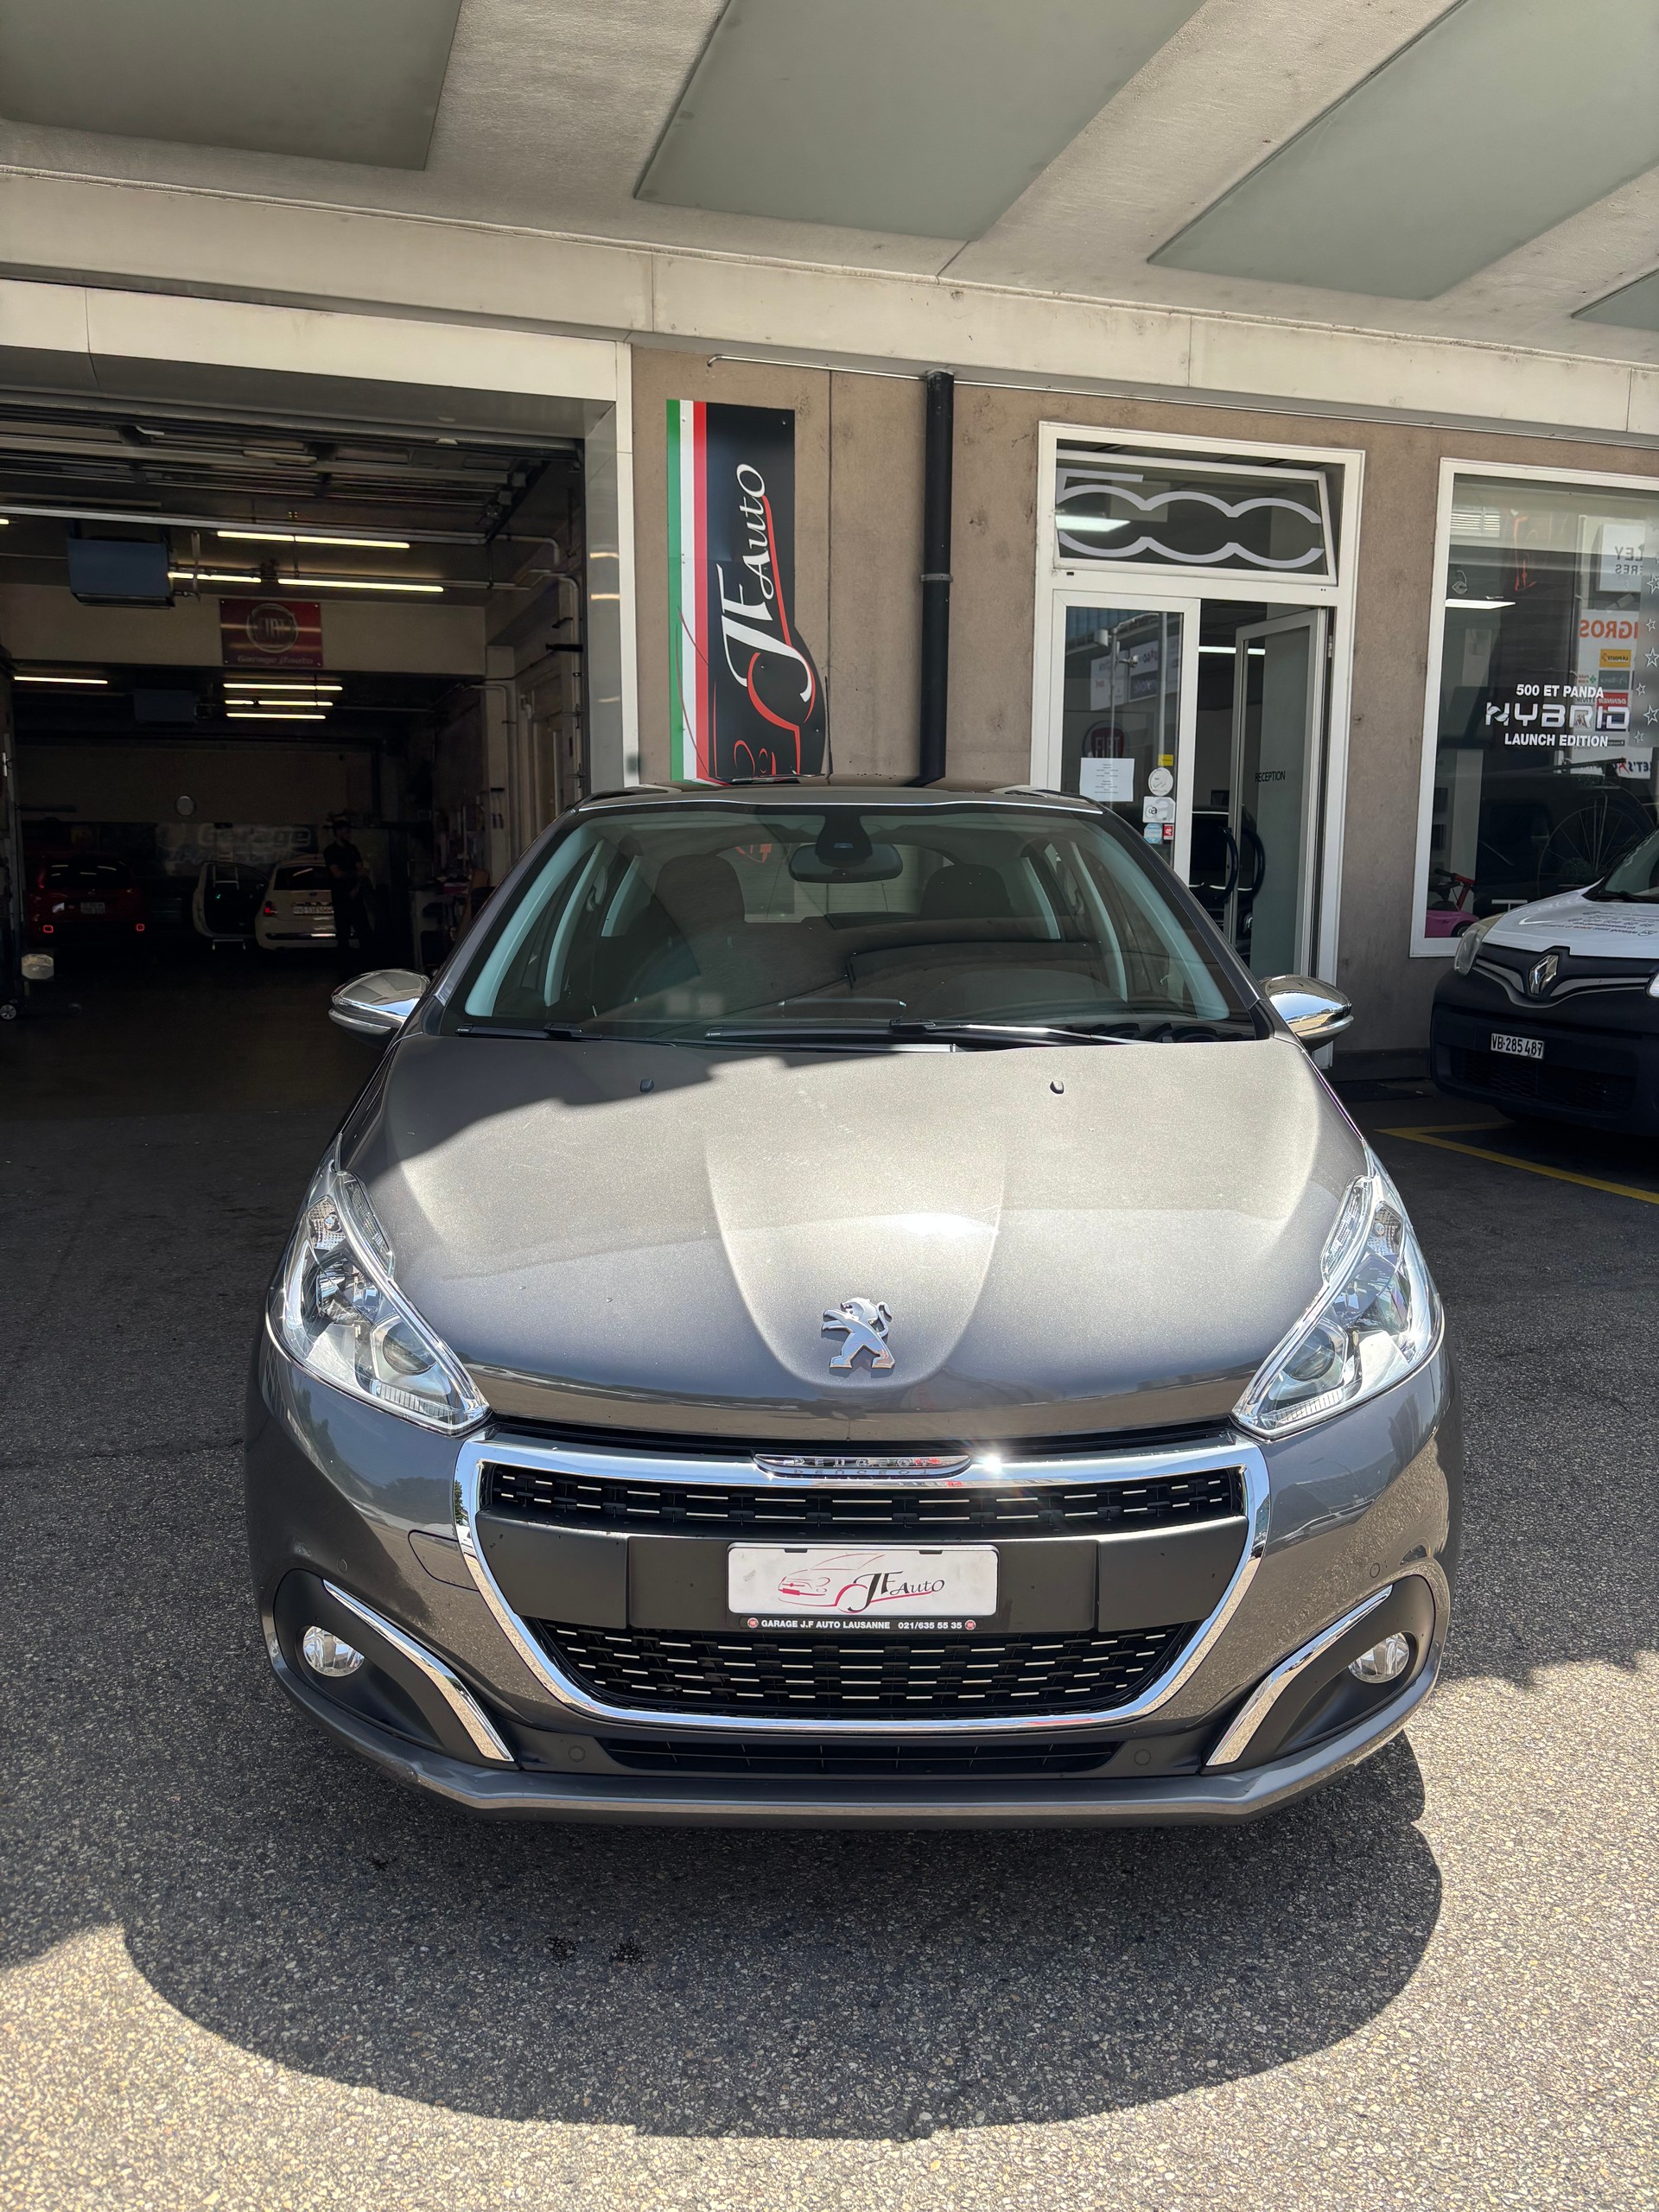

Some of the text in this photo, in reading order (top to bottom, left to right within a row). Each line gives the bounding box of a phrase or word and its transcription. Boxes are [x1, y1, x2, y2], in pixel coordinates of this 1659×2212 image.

[1516, 683, 1605, 699] 500 ET PANDA
[1485, 702, 1630, 729] HYBRID
[1504, 731, 1555, 747] LAUNCH
[1558, 733, 1609, 748] EDITION
[1255, 770, 1286, 783] RECEPTION
[848, 1570, 945, 1612] JF Auto
[760, 1619, 798, 1629] GARAGE
[800, 1619, 814, 1629] J.F
[815, 1619, 841, 1630] AUTO
[842, 1620, 891, 1630] LAUSANNE
[897, 1621, 935, 1630] 021/635
[936, 1621, 949, 1630] 55
[950, 1621, 963, 1630] 35
